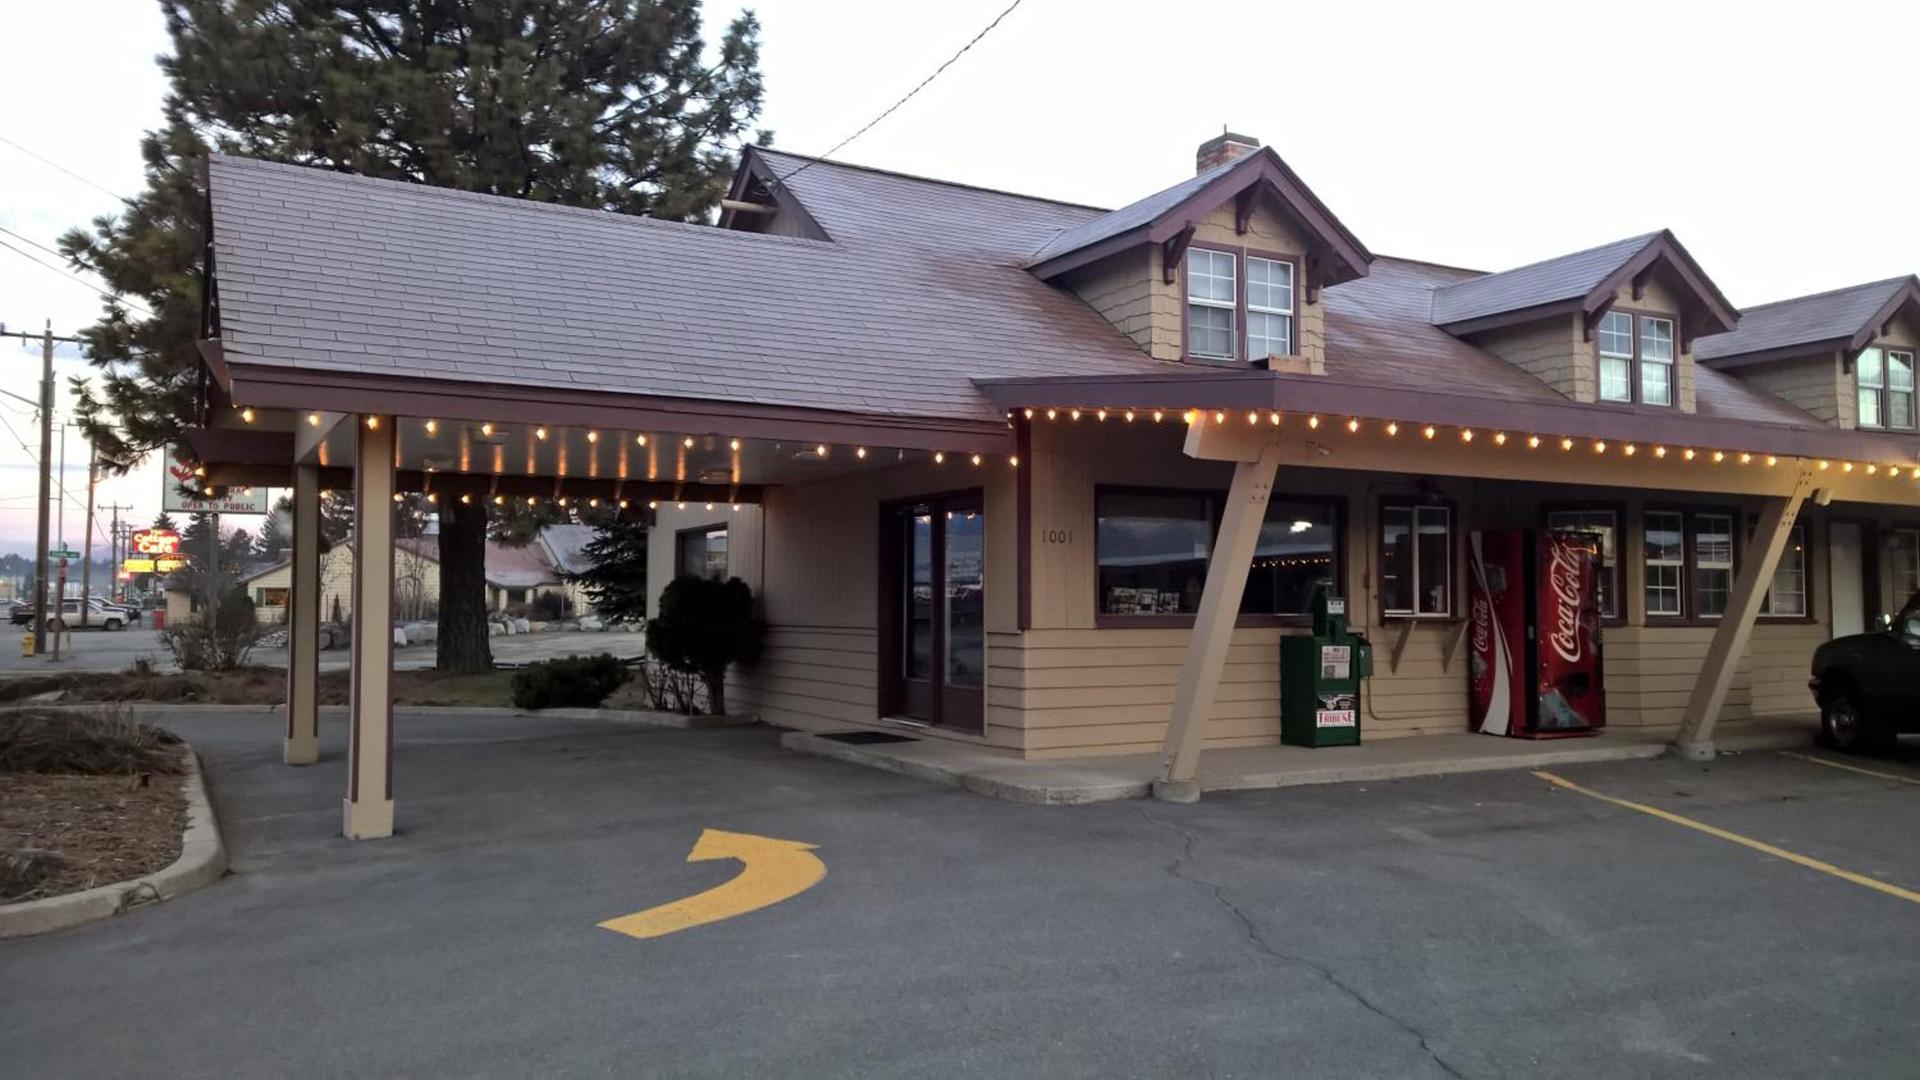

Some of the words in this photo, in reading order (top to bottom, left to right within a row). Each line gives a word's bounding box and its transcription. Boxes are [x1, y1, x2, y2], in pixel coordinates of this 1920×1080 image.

[182, 501, 204, 510] OPEN
[208, 502, 219, 510] TO
[223, 502, 256, 511] PUBLIC
[1042, 530, 1073, 543] 1001
[1319, 712, 1352, 724] TRIBUNE
